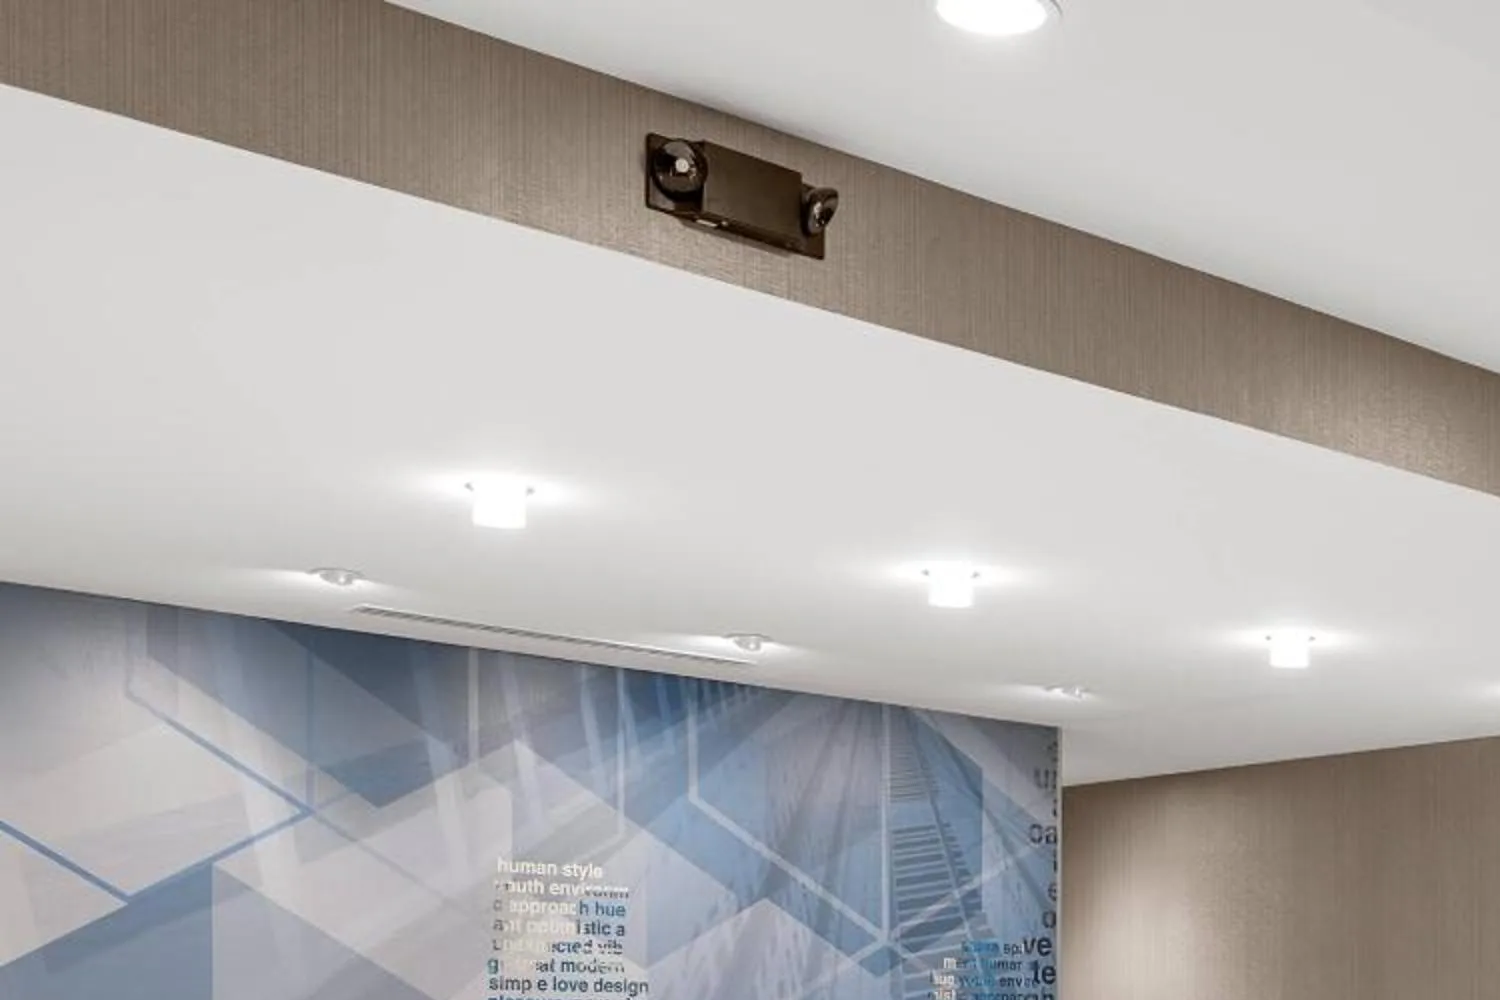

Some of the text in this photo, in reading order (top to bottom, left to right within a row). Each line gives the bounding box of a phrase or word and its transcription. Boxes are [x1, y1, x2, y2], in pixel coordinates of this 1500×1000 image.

[497, 857, 602, 881] human style
[595, 901, 626, 917] hue
[489, 977, 648, 996] simpe love design
